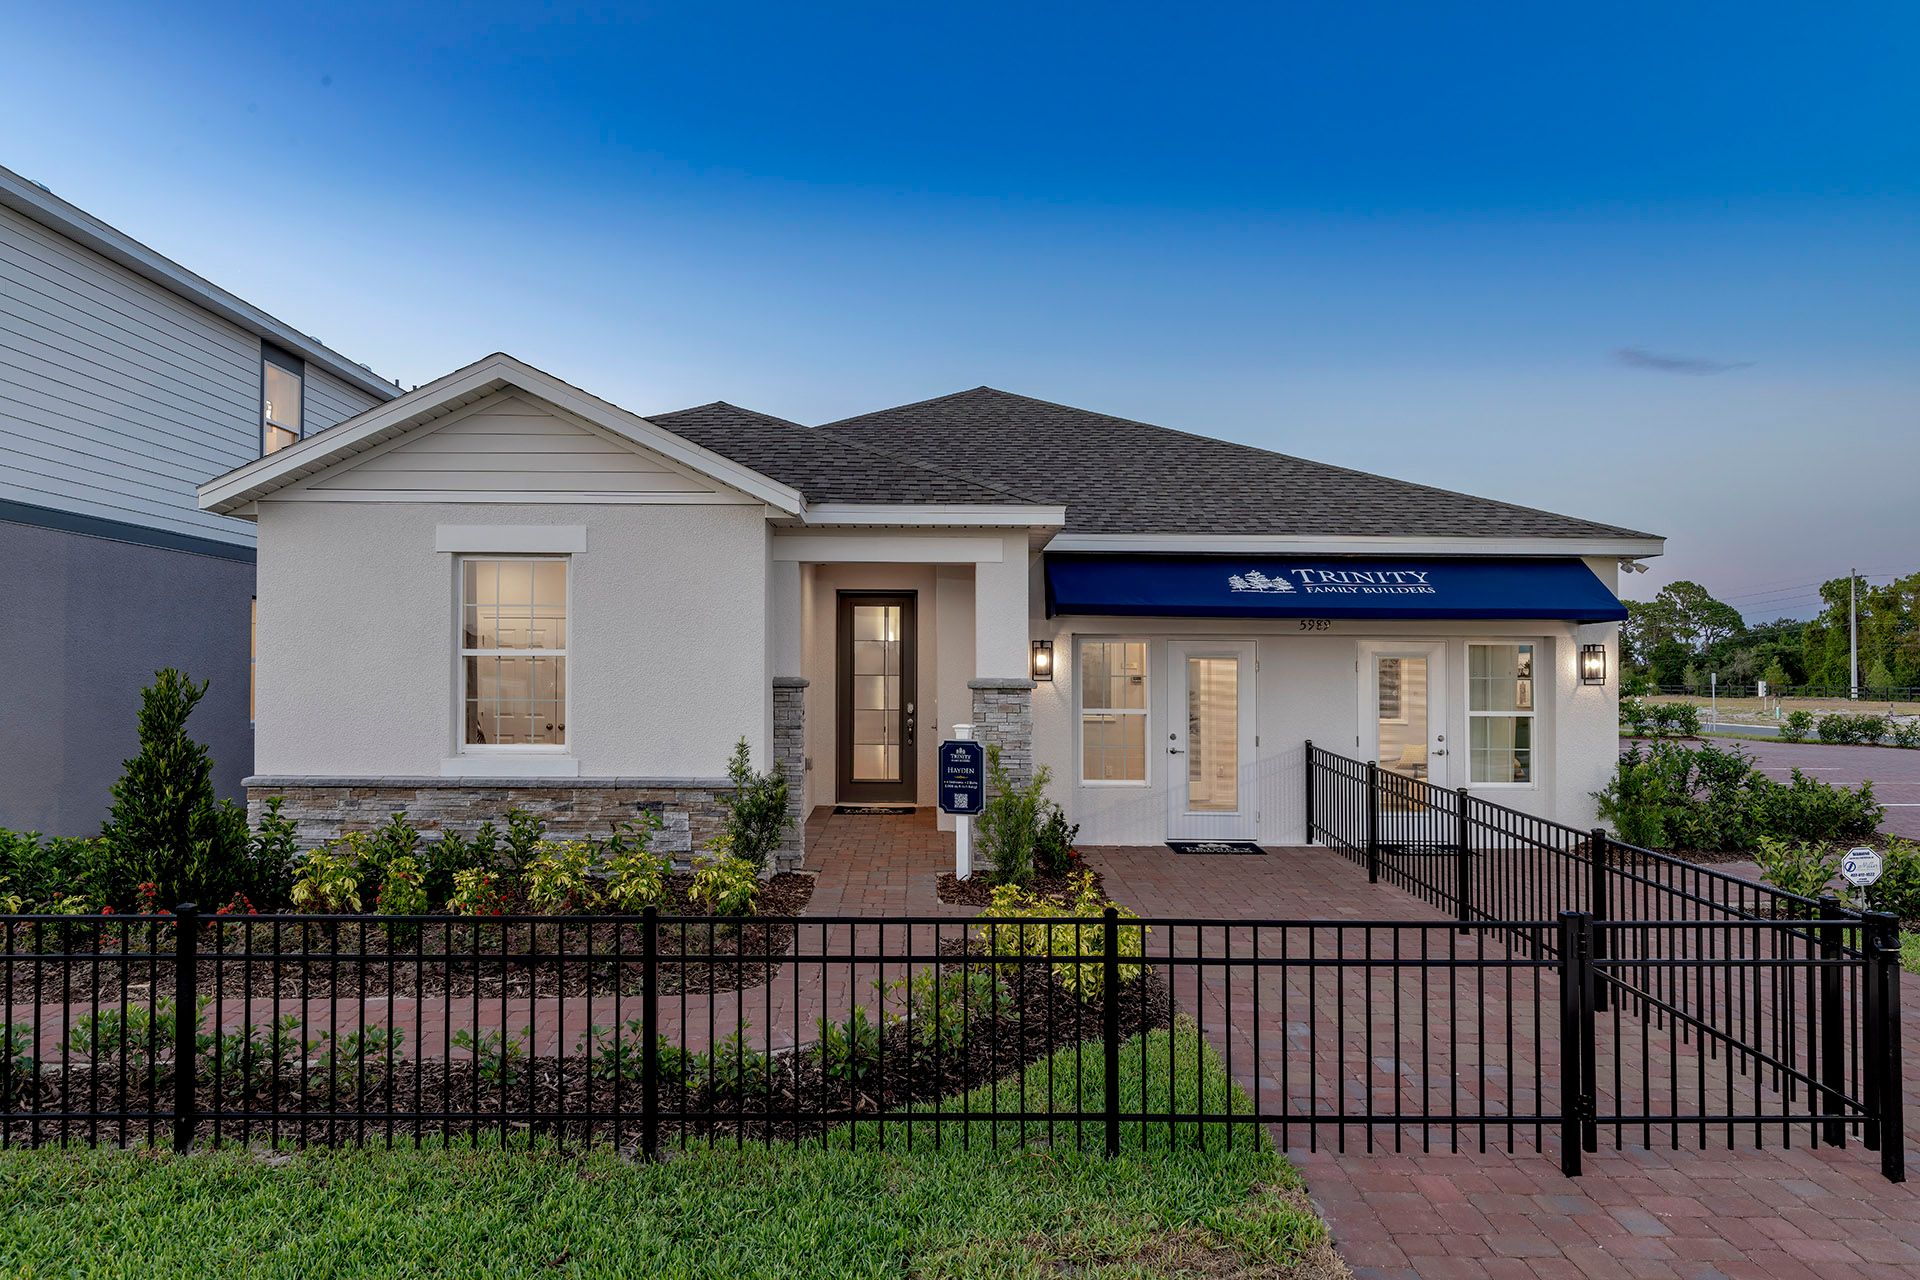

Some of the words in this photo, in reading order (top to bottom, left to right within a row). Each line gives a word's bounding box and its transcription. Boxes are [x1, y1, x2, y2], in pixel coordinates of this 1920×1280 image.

[1291, 568, 1429, 584] TRINITY
[1305, 586, 1359, 594] FAMILY
[1363, 586, 1437, 594] BUILDERS
[1299, 618, 1331, 631] 5989
